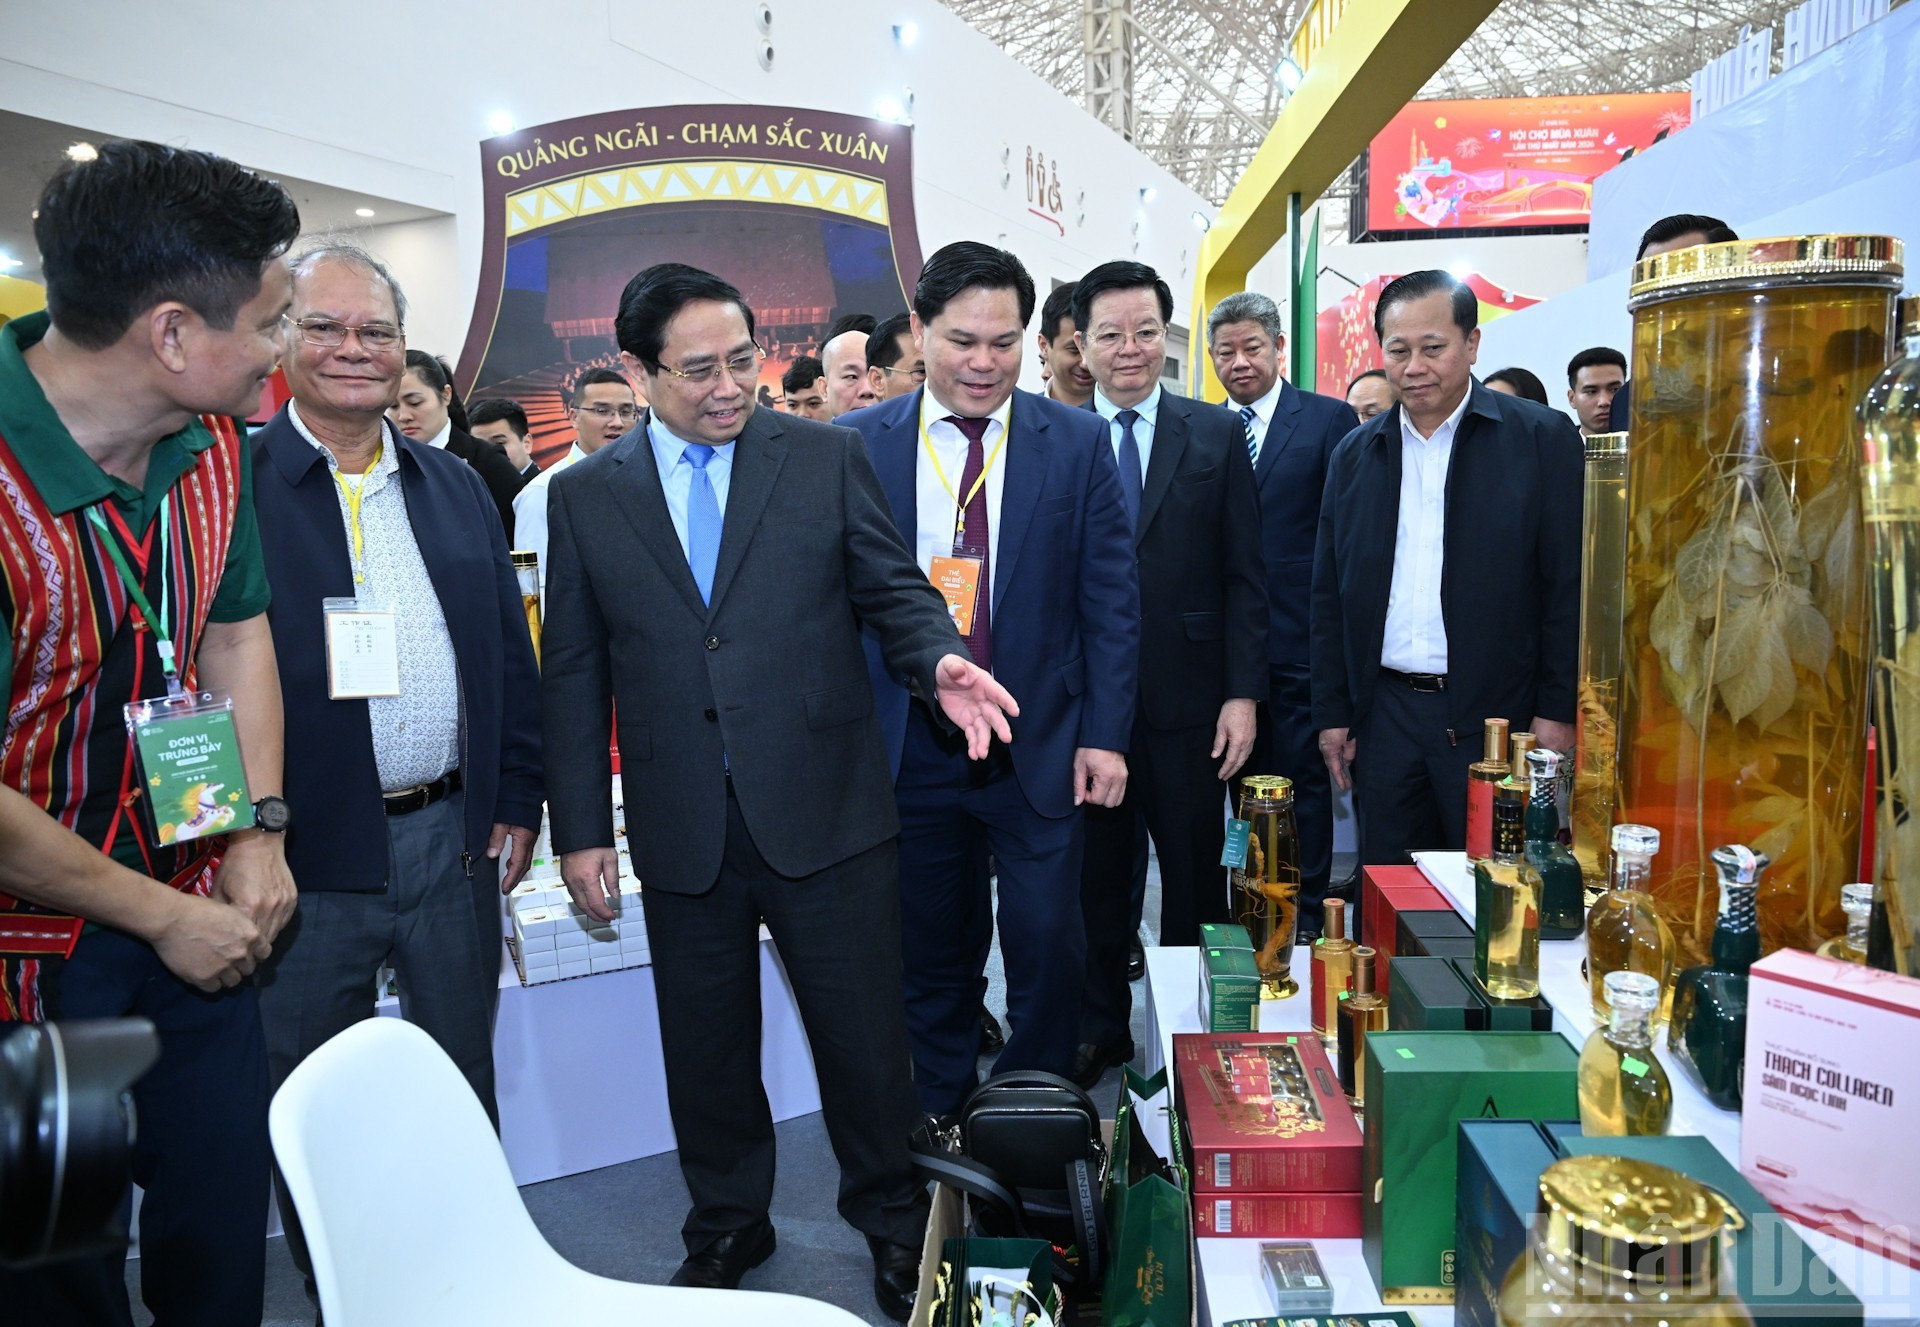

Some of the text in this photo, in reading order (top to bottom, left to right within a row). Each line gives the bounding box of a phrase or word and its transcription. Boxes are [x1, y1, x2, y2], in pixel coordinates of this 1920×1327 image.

[497, 138, 588, 177] QUẢNG
[595, 122, 658, 152] NGÃI
[682, 122, 758, 149] CHẠM
[766, 117, 812, 149] SẮC
[819, 132, 888, 164] XUÂN
[1509, 126, 1599, 141] HỘI CHỢ MÙA XUÂN
[158, 748, 199, 762] TRƯNG
[200, 741, 222, 755] BÀY
[168, 733, 209, 749] ĐƠN VỊ
[1762, 1073, 1847, 1111] SÂM NGỌC LINH
[1764, 1050, 1894, 1107] THẠCH COLLAGEN
[1075, 1160, 1097, 1252] GIO BERNINI
